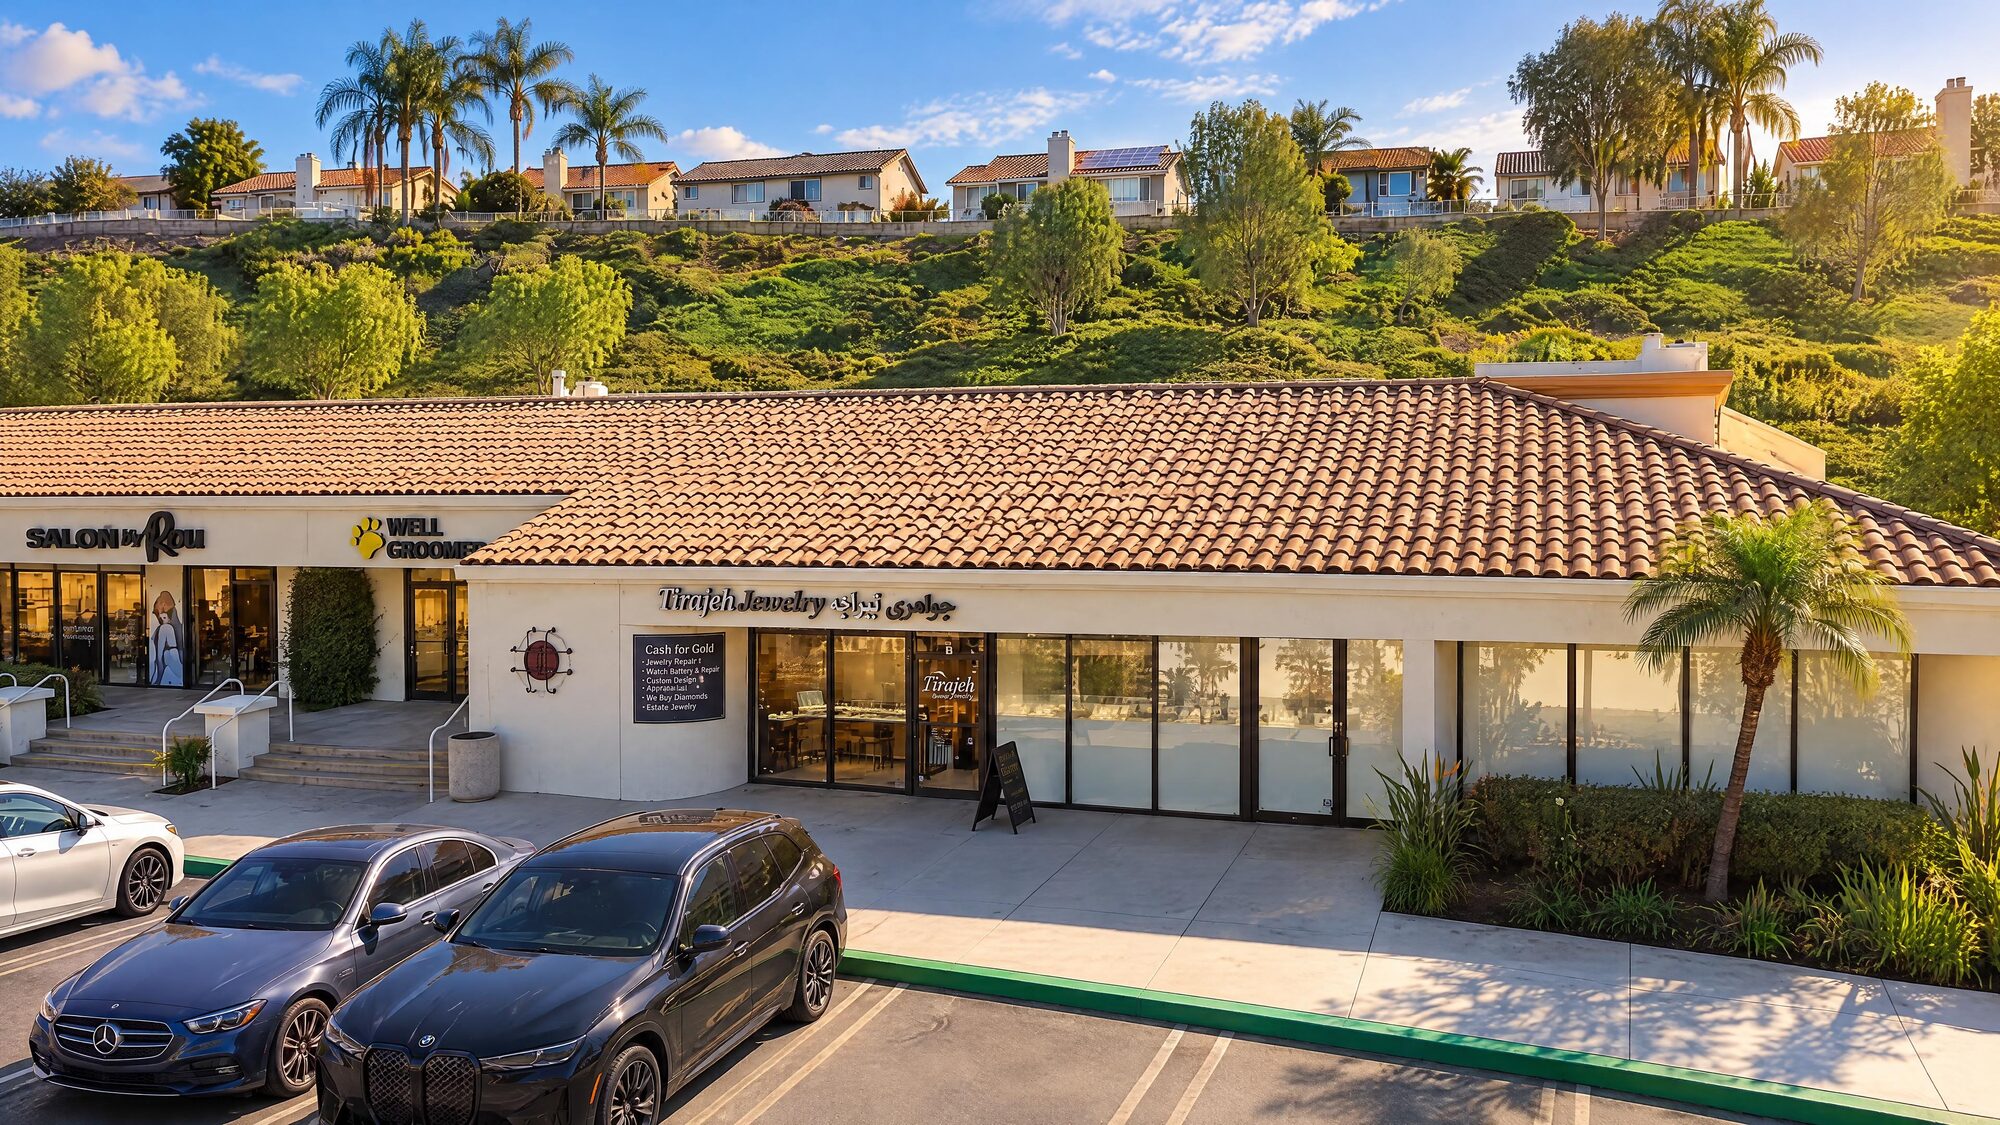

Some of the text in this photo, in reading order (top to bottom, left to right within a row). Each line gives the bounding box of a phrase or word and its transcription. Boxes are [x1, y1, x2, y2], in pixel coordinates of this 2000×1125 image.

[386, 517, 444, 537] WELL
[26, 528, 119, 549] SALON
[140, 511, 205, 562] Rou
[659, 587, 826, 619] Tirajeh Jewelry
[645, 643, 714, 655] Cash for Gold
[645, 658, 673, 667] Jewelry
[674, 657, 697, 666] Repair
[669, 667, 694, 676] Battery
[701, 665, 720, 675] Repair
[673, 676, 697, 685] Design
[922, 675, 975, 697] Tirajeh
[646, 692, 708, 703] We Buy Diamonds
[646, 702, 697, 712] Estate Jewelry
